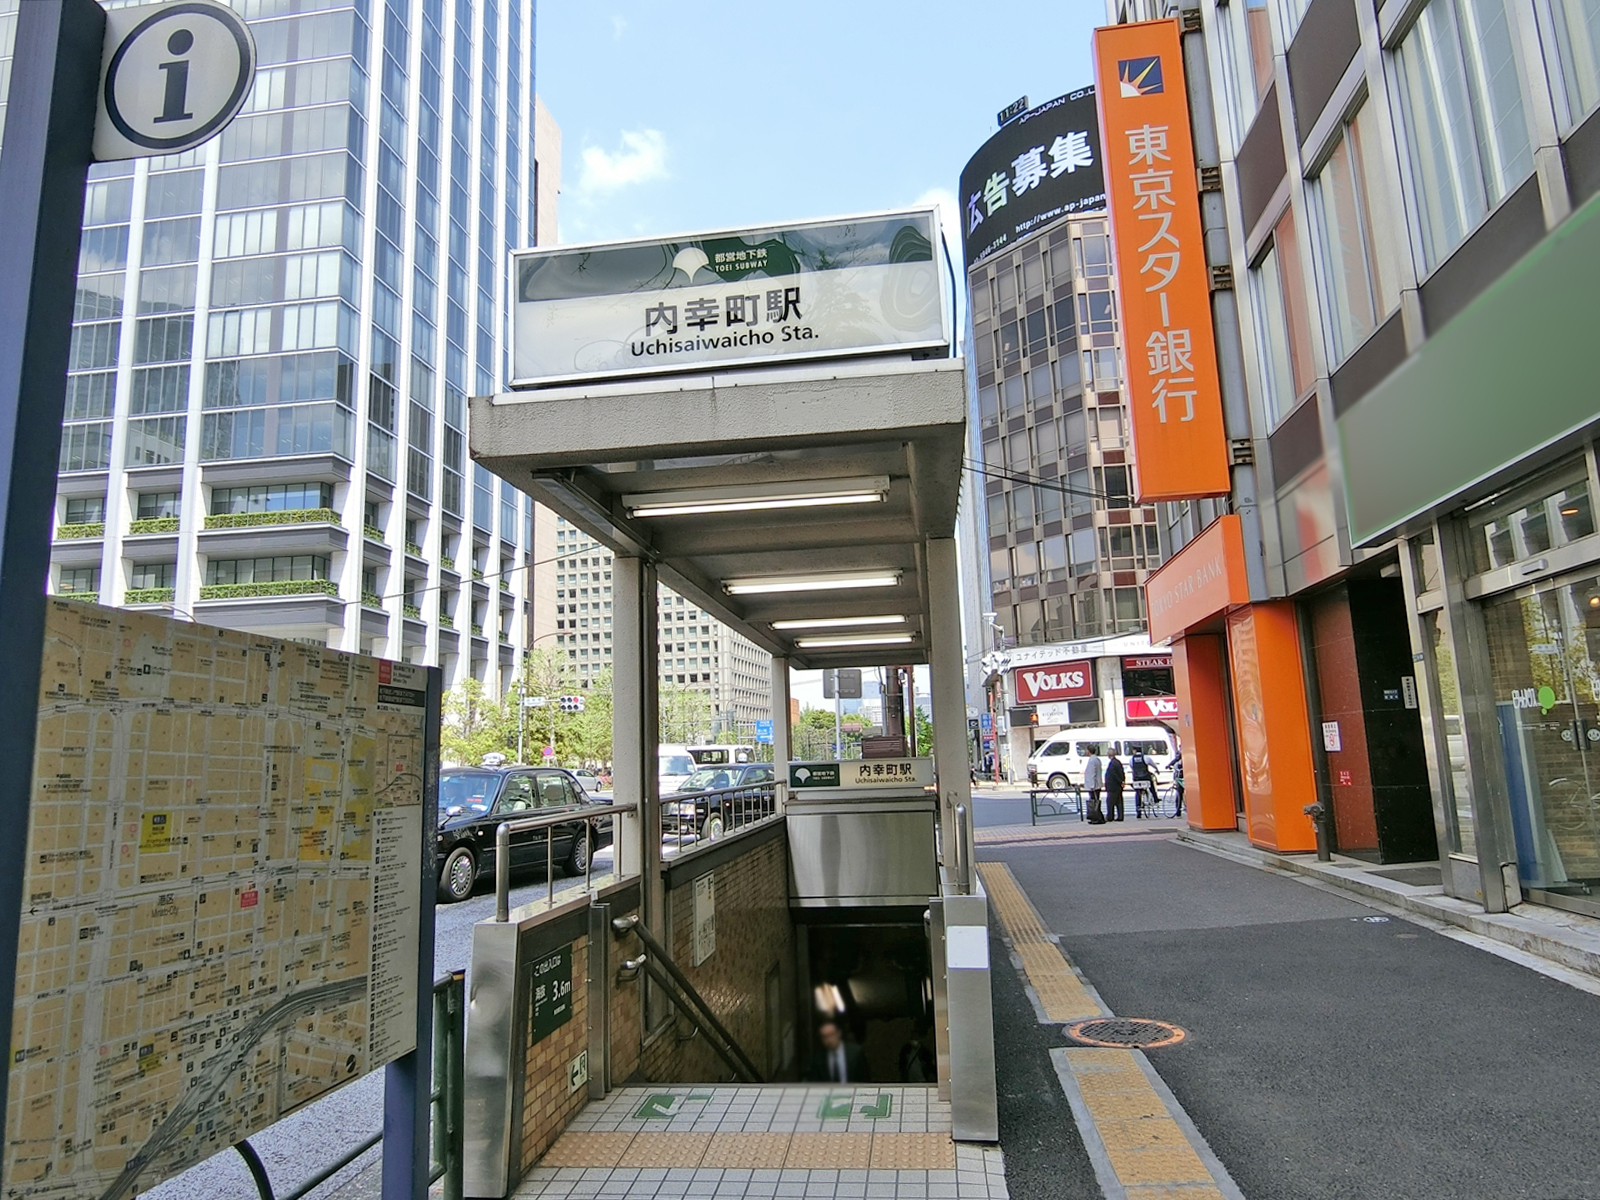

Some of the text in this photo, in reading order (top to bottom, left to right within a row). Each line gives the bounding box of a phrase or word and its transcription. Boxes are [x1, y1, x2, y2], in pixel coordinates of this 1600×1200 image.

[1000, 98, 1025, 122] 11:22
[967, 131, 1094, 239] 広告募集
[714, 248, 768, 263] 都営地下鉄
[715, 260, 768, 273] TOEI SUBWAY
[1125, 124, 1197, 424] 東京スター銀行
[645, 286, 803, 337] 内幸町駅
[631, 325, 820, 357] Uchisaiwaicho Sta.
[1151, 554, 1222, 617] TOKYO STAR BANK
[1015, 644, 1089, 661] ユナイテッド不動産
[1136, 658, 1164, 667] STEAK
[1023, 670, 1085, 698] VOLKS
[855, 776, 903, 784] Uchisaiwaicho
[859, 763, 912, 777] 内幸町駅
[552, 980, 571, 1002] 3.6m
